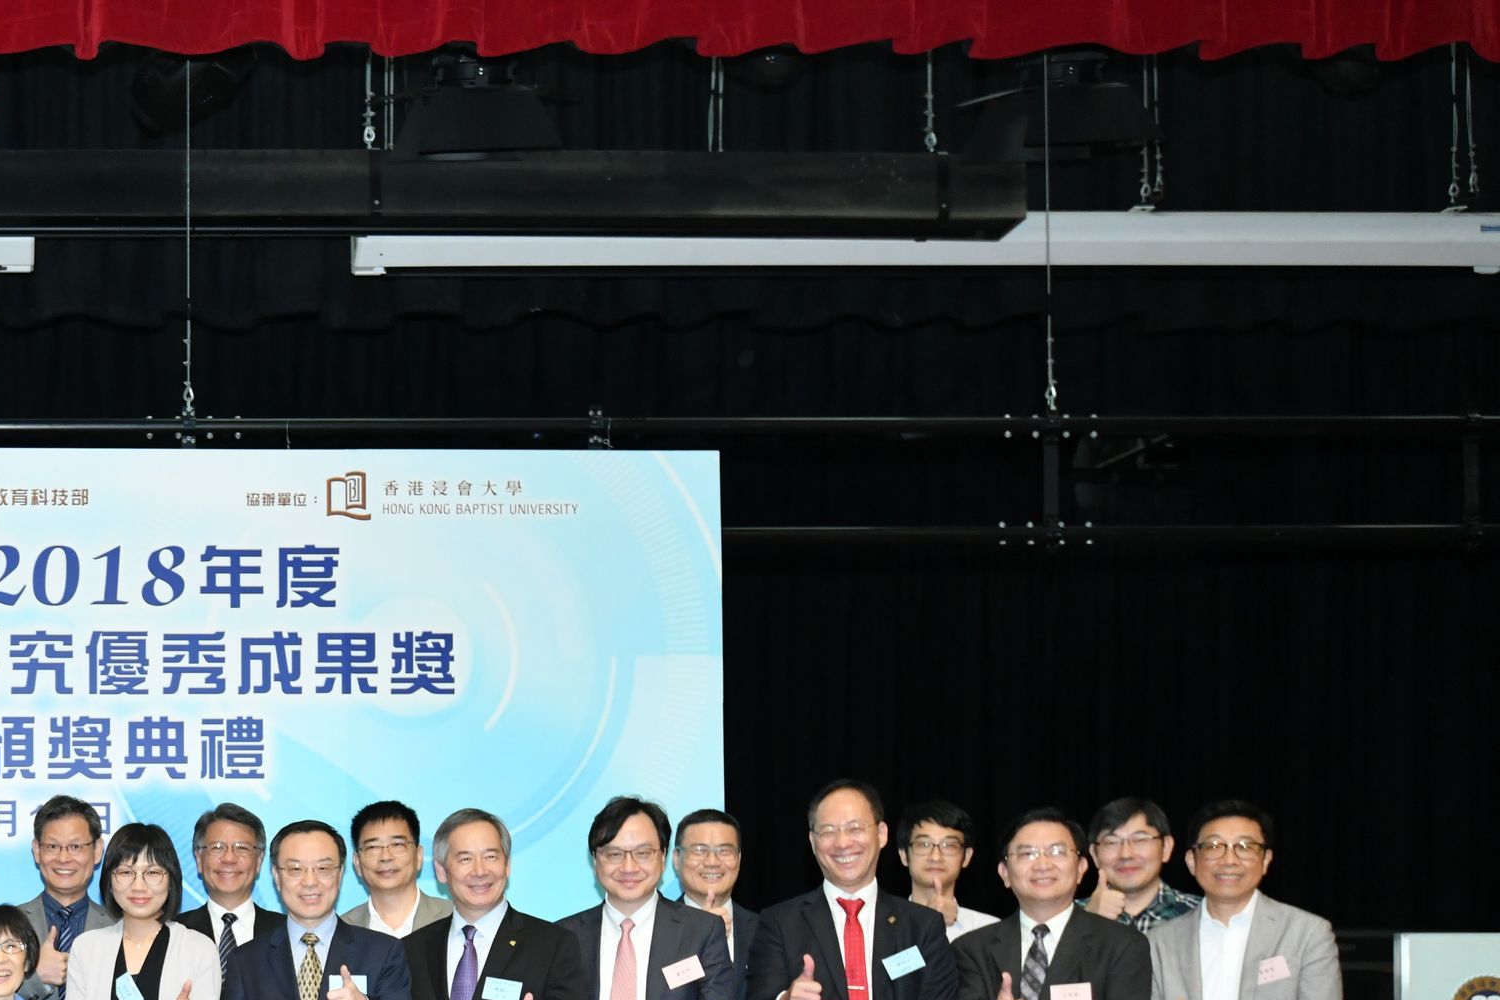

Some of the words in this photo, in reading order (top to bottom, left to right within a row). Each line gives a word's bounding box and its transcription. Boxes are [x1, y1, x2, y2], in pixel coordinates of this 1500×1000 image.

[383, 479, 524, 497] 香港浸會大學
[382, 502, 414, 515] HONG
[419, 502, 450, 515] KONG
[456, 502, 504, 515] BAPTIST
[509, 502, 579, 515] UNIVERSITY
